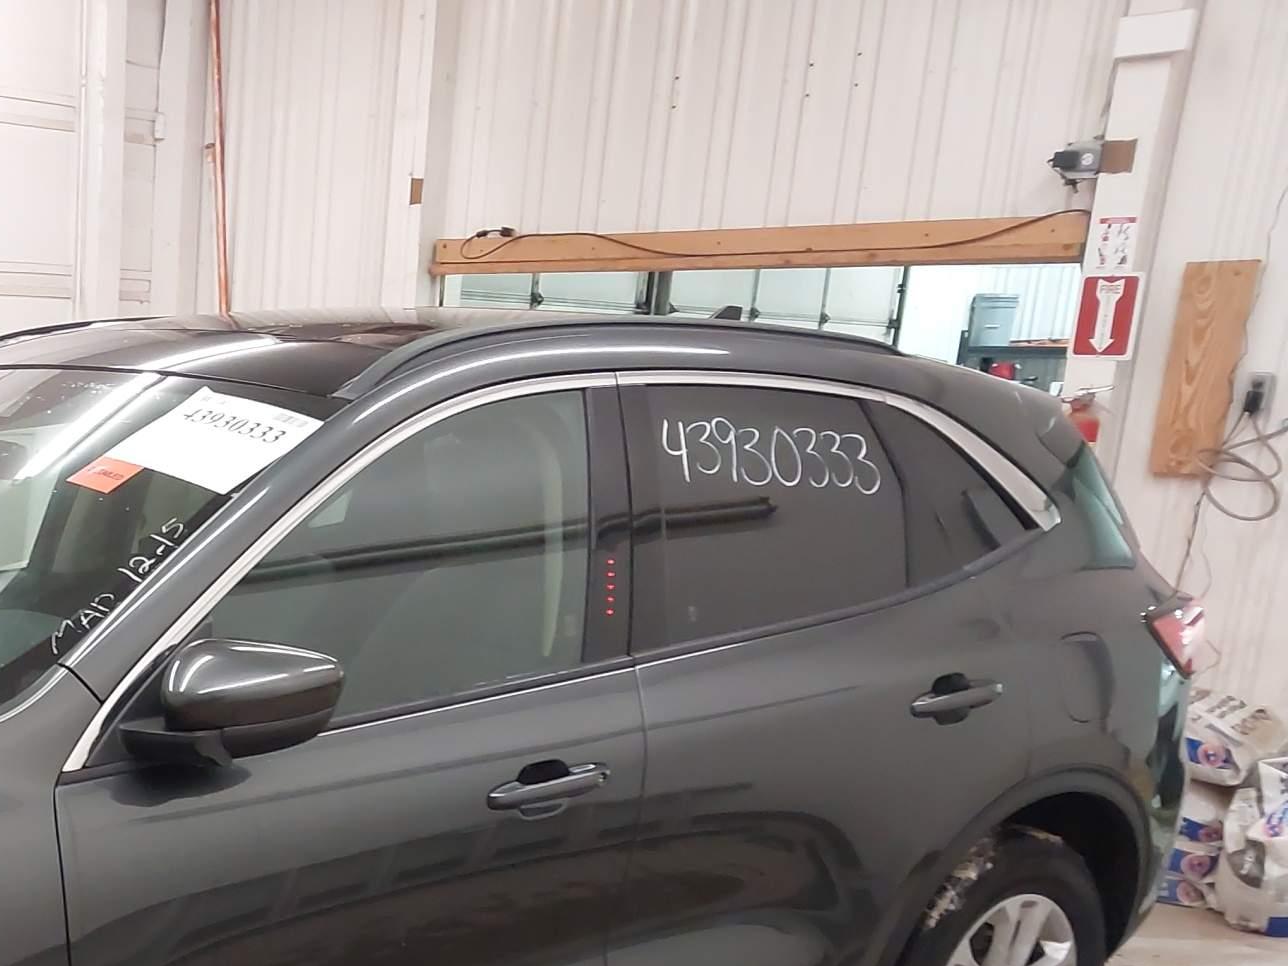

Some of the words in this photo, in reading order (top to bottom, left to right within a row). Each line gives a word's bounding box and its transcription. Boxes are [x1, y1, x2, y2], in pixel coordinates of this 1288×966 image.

[183, 409, 287, 443] 43930333
[662, 416, 880, 494] 43930333
[117, 517, 184, 583] 12-15
